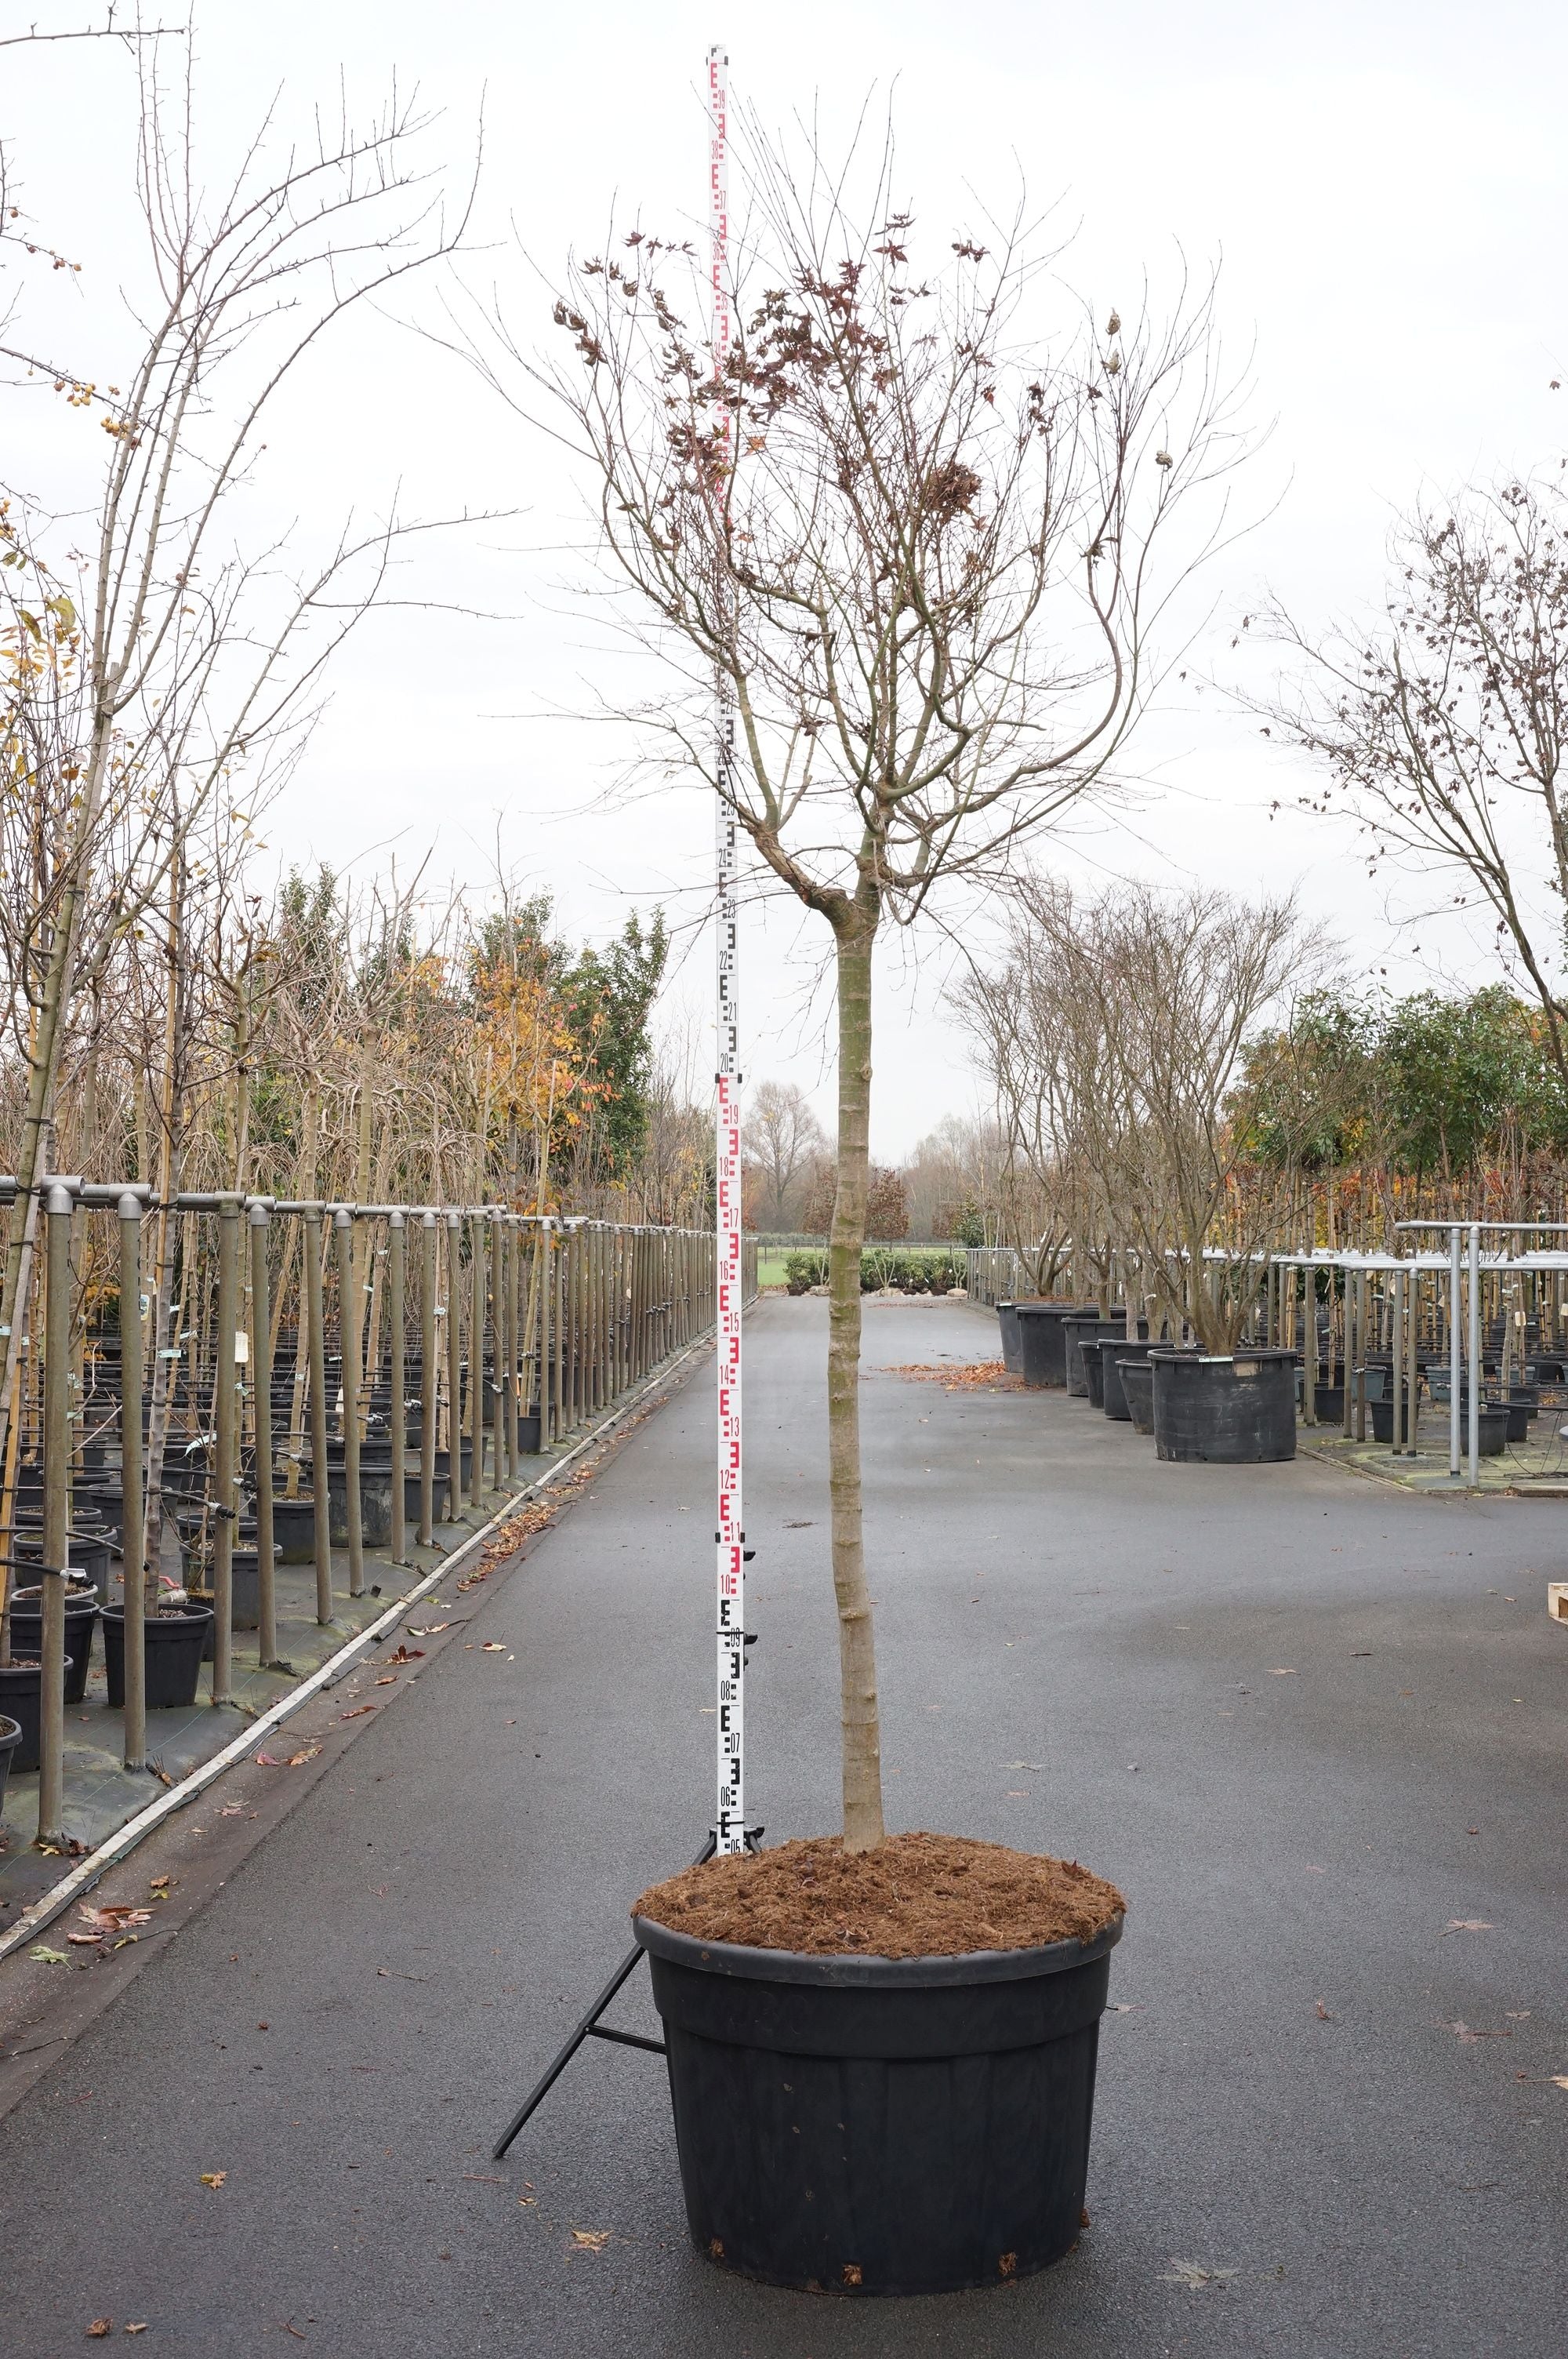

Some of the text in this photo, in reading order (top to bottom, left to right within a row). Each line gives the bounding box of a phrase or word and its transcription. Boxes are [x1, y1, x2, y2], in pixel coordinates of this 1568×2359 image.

[717, 89, 725, 109] 39
[711, 140, 719, 160] 38
[719, 191, 727, 209] 37
[713, 241, 720, 261] 36
[720, 291, 728, 311] 35
[718, 849, 726, 867] 24
[728, 899, 735, 918] 23
[720, 951, 728, 970] 22
[728, 1001, 737, 1022] 21
[720, 1053, 728, 1073] 20
[729, 1104, 739, 1125] 19
[720, 1157, 729, 1176] 18
[729, 1209, 739, 1228] 17
[720, 1260, 728, 1281] 16
[730, 1312, 739, 1332] 15
[720, 1365, 729, 1385] 14
[730, 1417, 739, 1437] 13
[720, 1469, 730, 1489] 12
[731, 1522, 740, 1542] 11
[720, 1575, 730, 1594] 10
[731, 1627, 740, 1647] 09
[720, 1681, 730, 1700] 08
[731, 1732, 740, 1753] 07
[720, 1787, 730, 1807] 06
[731, 1839, 740, 1854] 05
